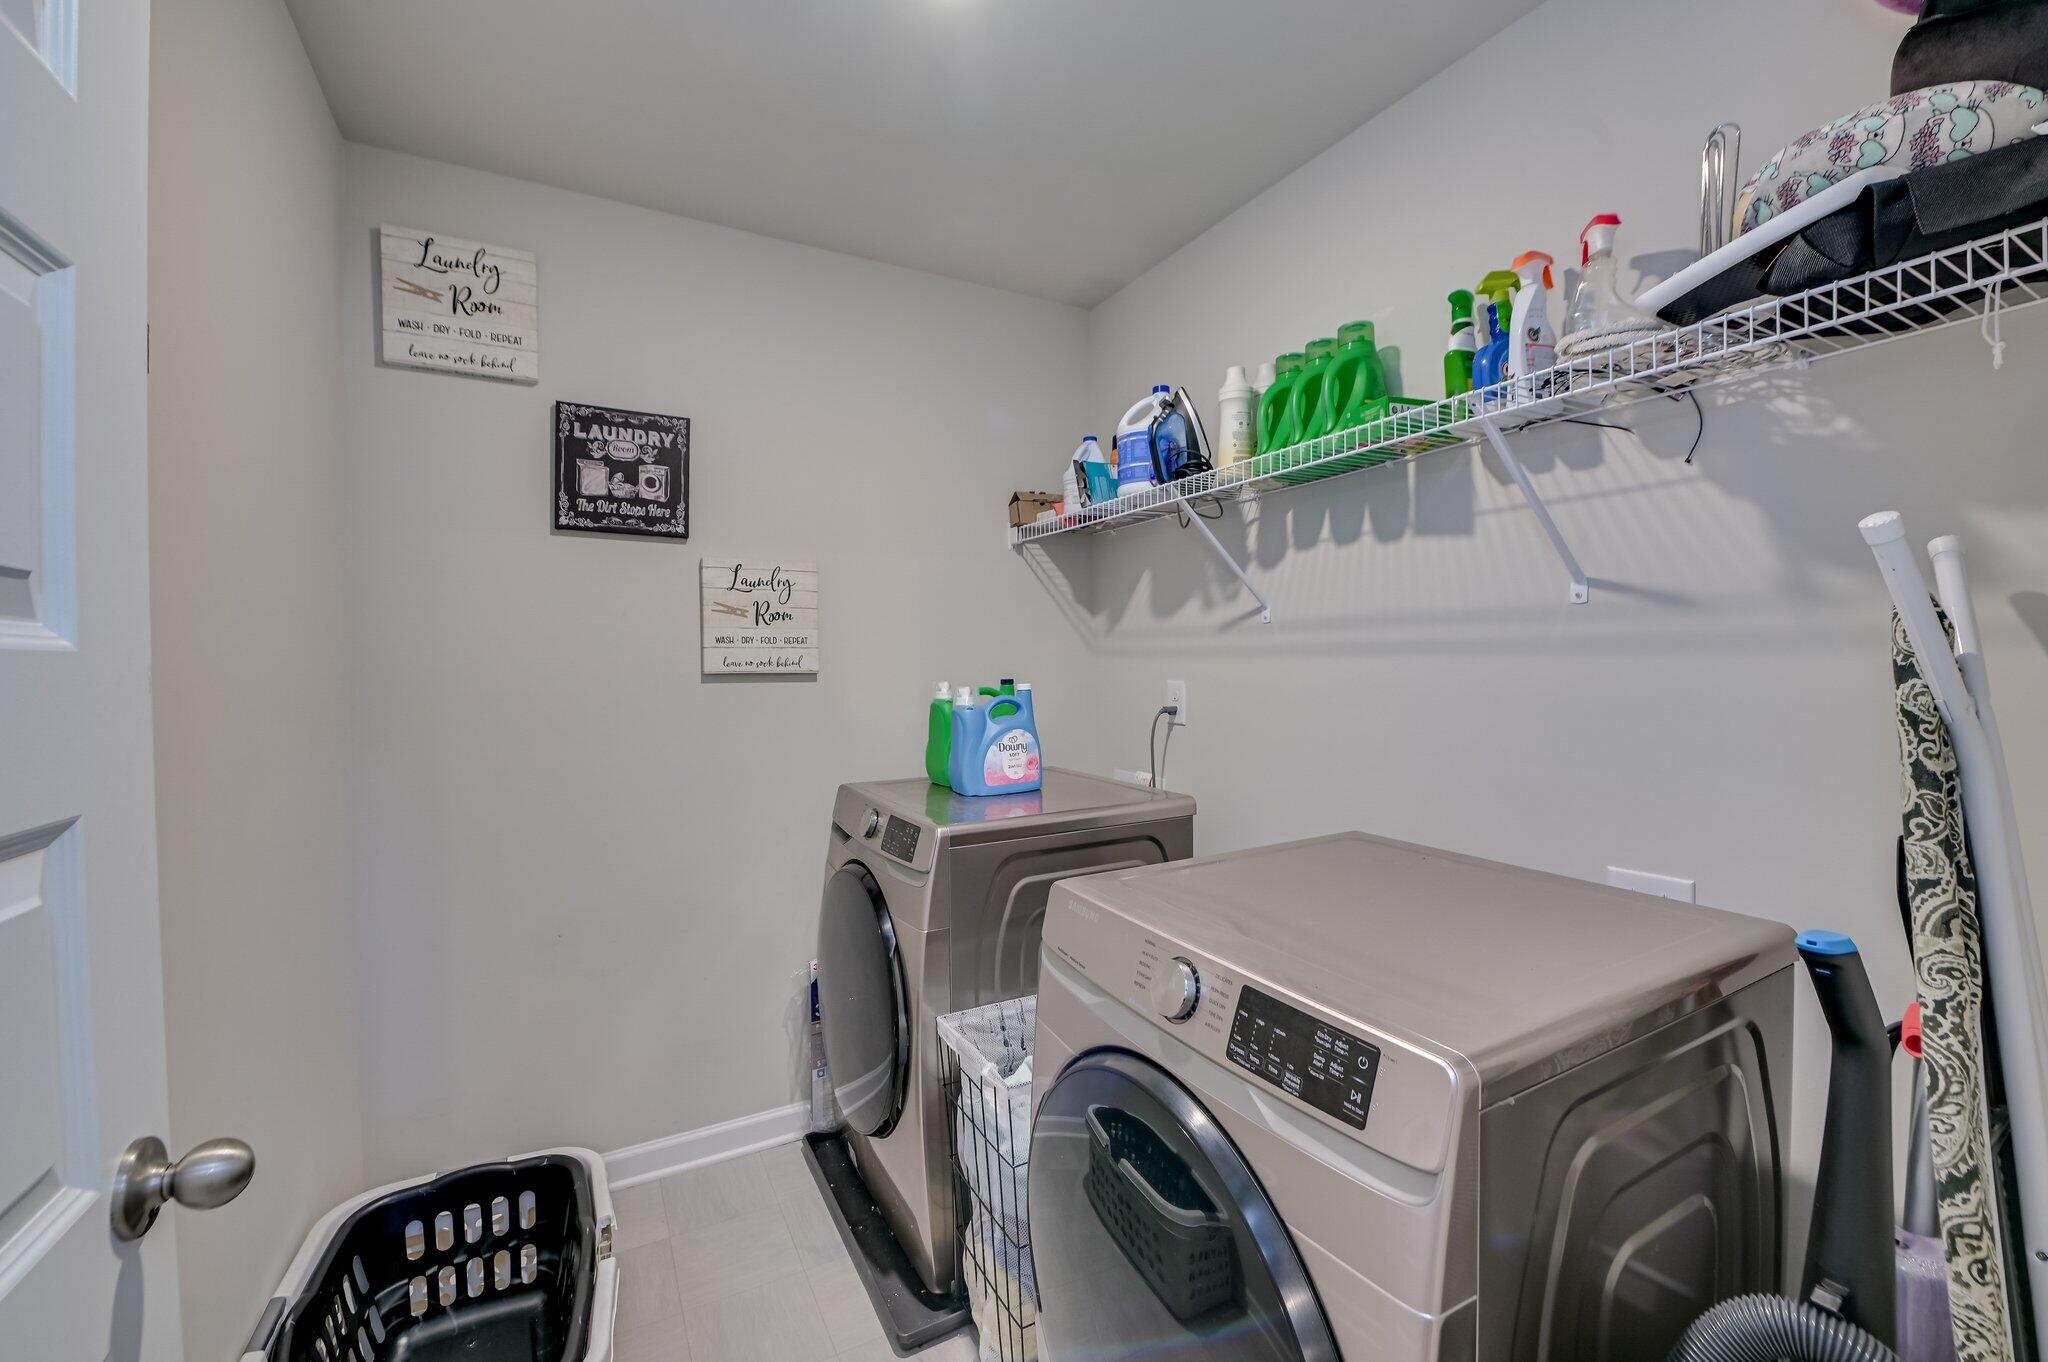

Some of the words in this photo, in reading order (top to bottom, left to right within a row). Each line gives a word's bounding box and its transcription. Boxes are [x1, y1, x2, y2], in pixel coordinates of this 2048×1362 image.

[413, 237, 506, 295] Laundry
[449, 284, 503, 317] Room
[398, 317, 424, 331] WASH
[433, 323, 451, 335] DRY
[459, 327, 482, 340] FOLD
[490, 332, 523, 346] REPEAT
[408, 343, 434, 360] leave
[438, 353, 449, 361] no
[453, 353, 479, 366] sock
[481, 355, 517, 373] behind
[573, 421, 675, 449] LAUNDRY
[611, 443, 636, 455] Room
[576, 498, 595, 513] The
[596, 500, 617, 513] Dirt
[619, 501, 646, 516] Stops
[647, 503, 671, 518] Here
[727, 563, 796, 605] Laundry
[752, 600, 793, 626] Room
[715, 636, 734, 645] WASH
[741, 636, 755, 645] DRY
[760, 636, 778, 645] FOLD
[783, 636, 809, 645] REPEAT
[722, 655, 743, 668] leave
[744, 660, 754, 668] no
[755, 657, 775, 668] sock
[776, 654, 803, 668] behind
[998, 742, 1028, 753] Downy
